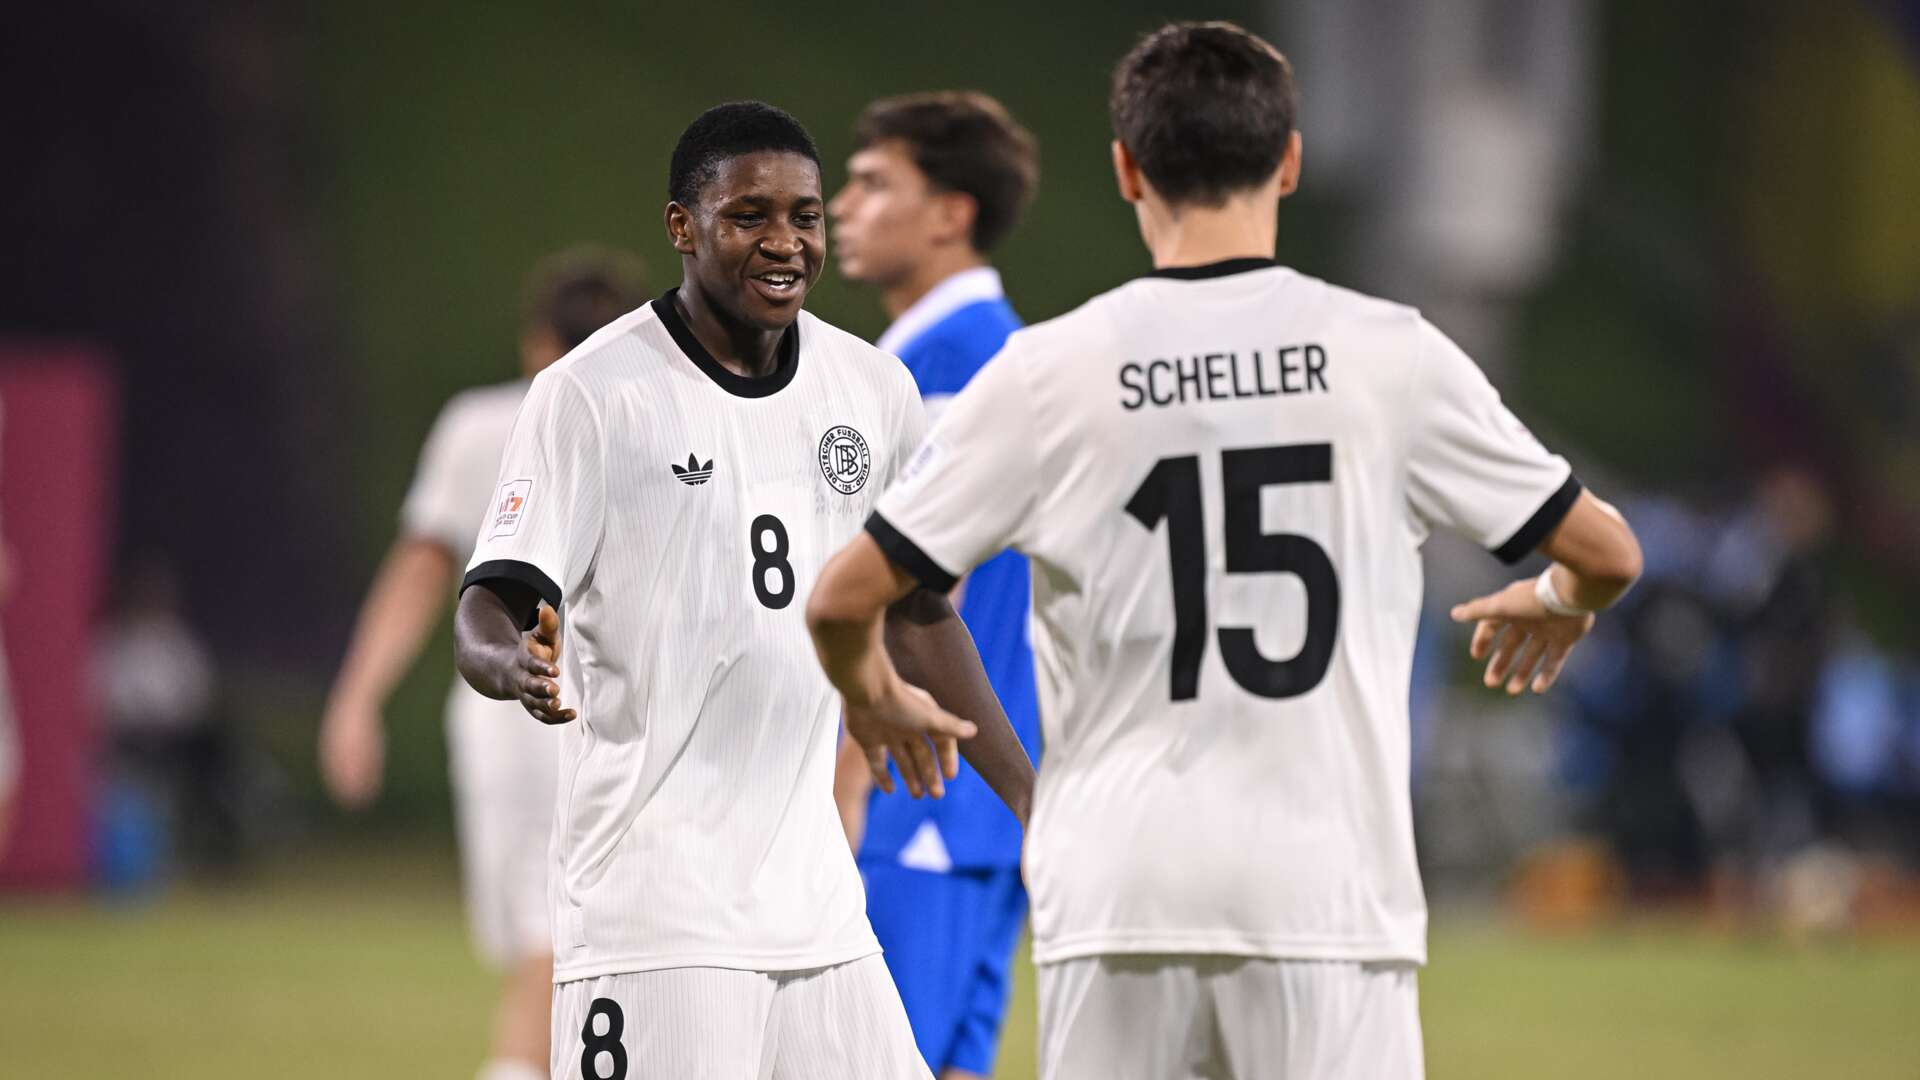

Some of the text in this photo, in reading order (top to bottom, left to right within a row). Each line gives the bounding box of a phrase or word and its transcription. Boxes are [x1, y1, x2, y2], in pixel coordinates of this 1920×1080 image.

[1119, 344, 1328, 410] SCHELLER
[822, 432, 838, 484] DEUTSCHER
[750, 514, 796, 610] 8
[1123, 442, 1341, 702] 15
[580, 997, 628, 1080] 8
